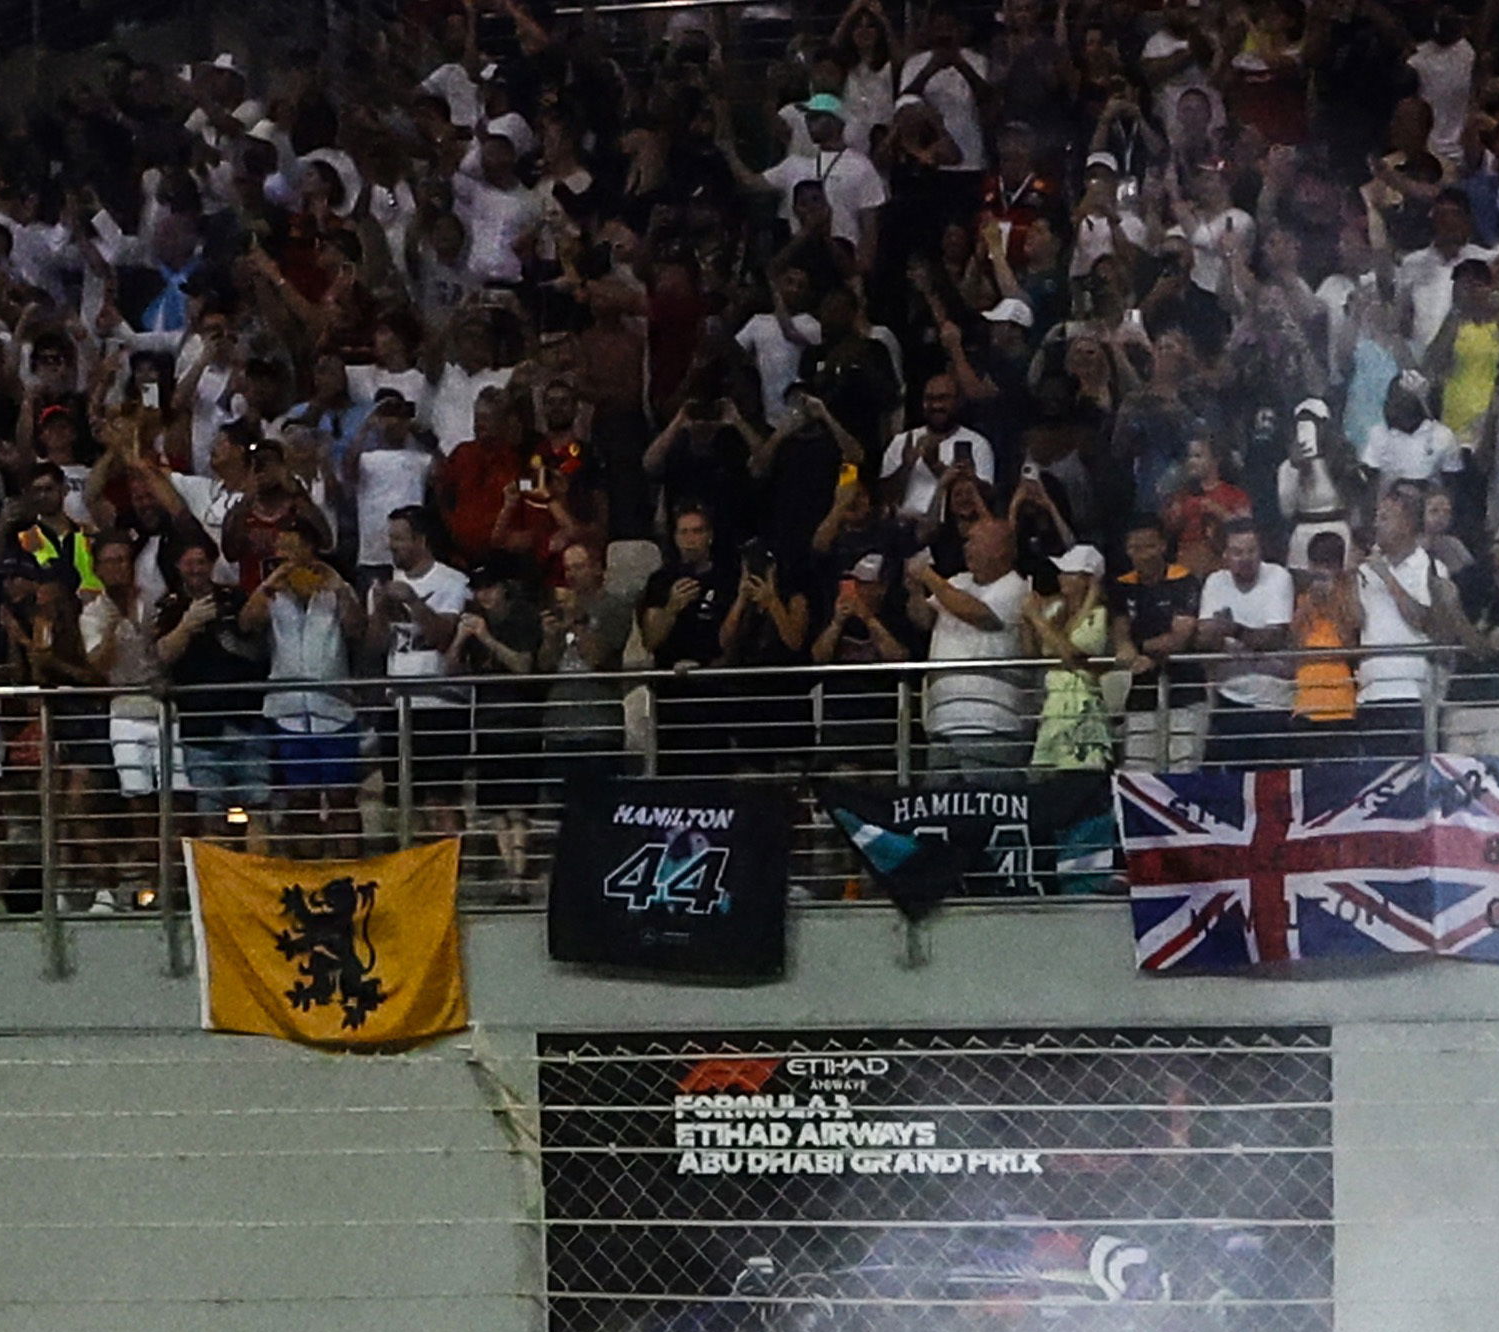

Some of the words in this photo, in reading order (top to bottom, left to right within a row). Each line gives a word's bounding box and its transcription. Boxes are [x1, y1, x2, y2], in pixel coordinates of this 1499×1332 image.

[613, 804, 735, 830] HAMILTON
[893, 792, 1030, 823] HAMILTON
[604, 843, 731, 915] 44
[786, 1057, 890, 1076] ETIHAD
[674, 1094, 827, 1120] FORMULA
[675, 1121, 792, 1147] ETIHAD
[797, 1120, 937, 1146] AIRWAYS
[677, 1151, 745, 1174] ABU
[748, 1152, 845, 1175] DHABI
[850, 1152, 965, 1175] GRAND
[966, 1152, 1044, 1174] PRIX
